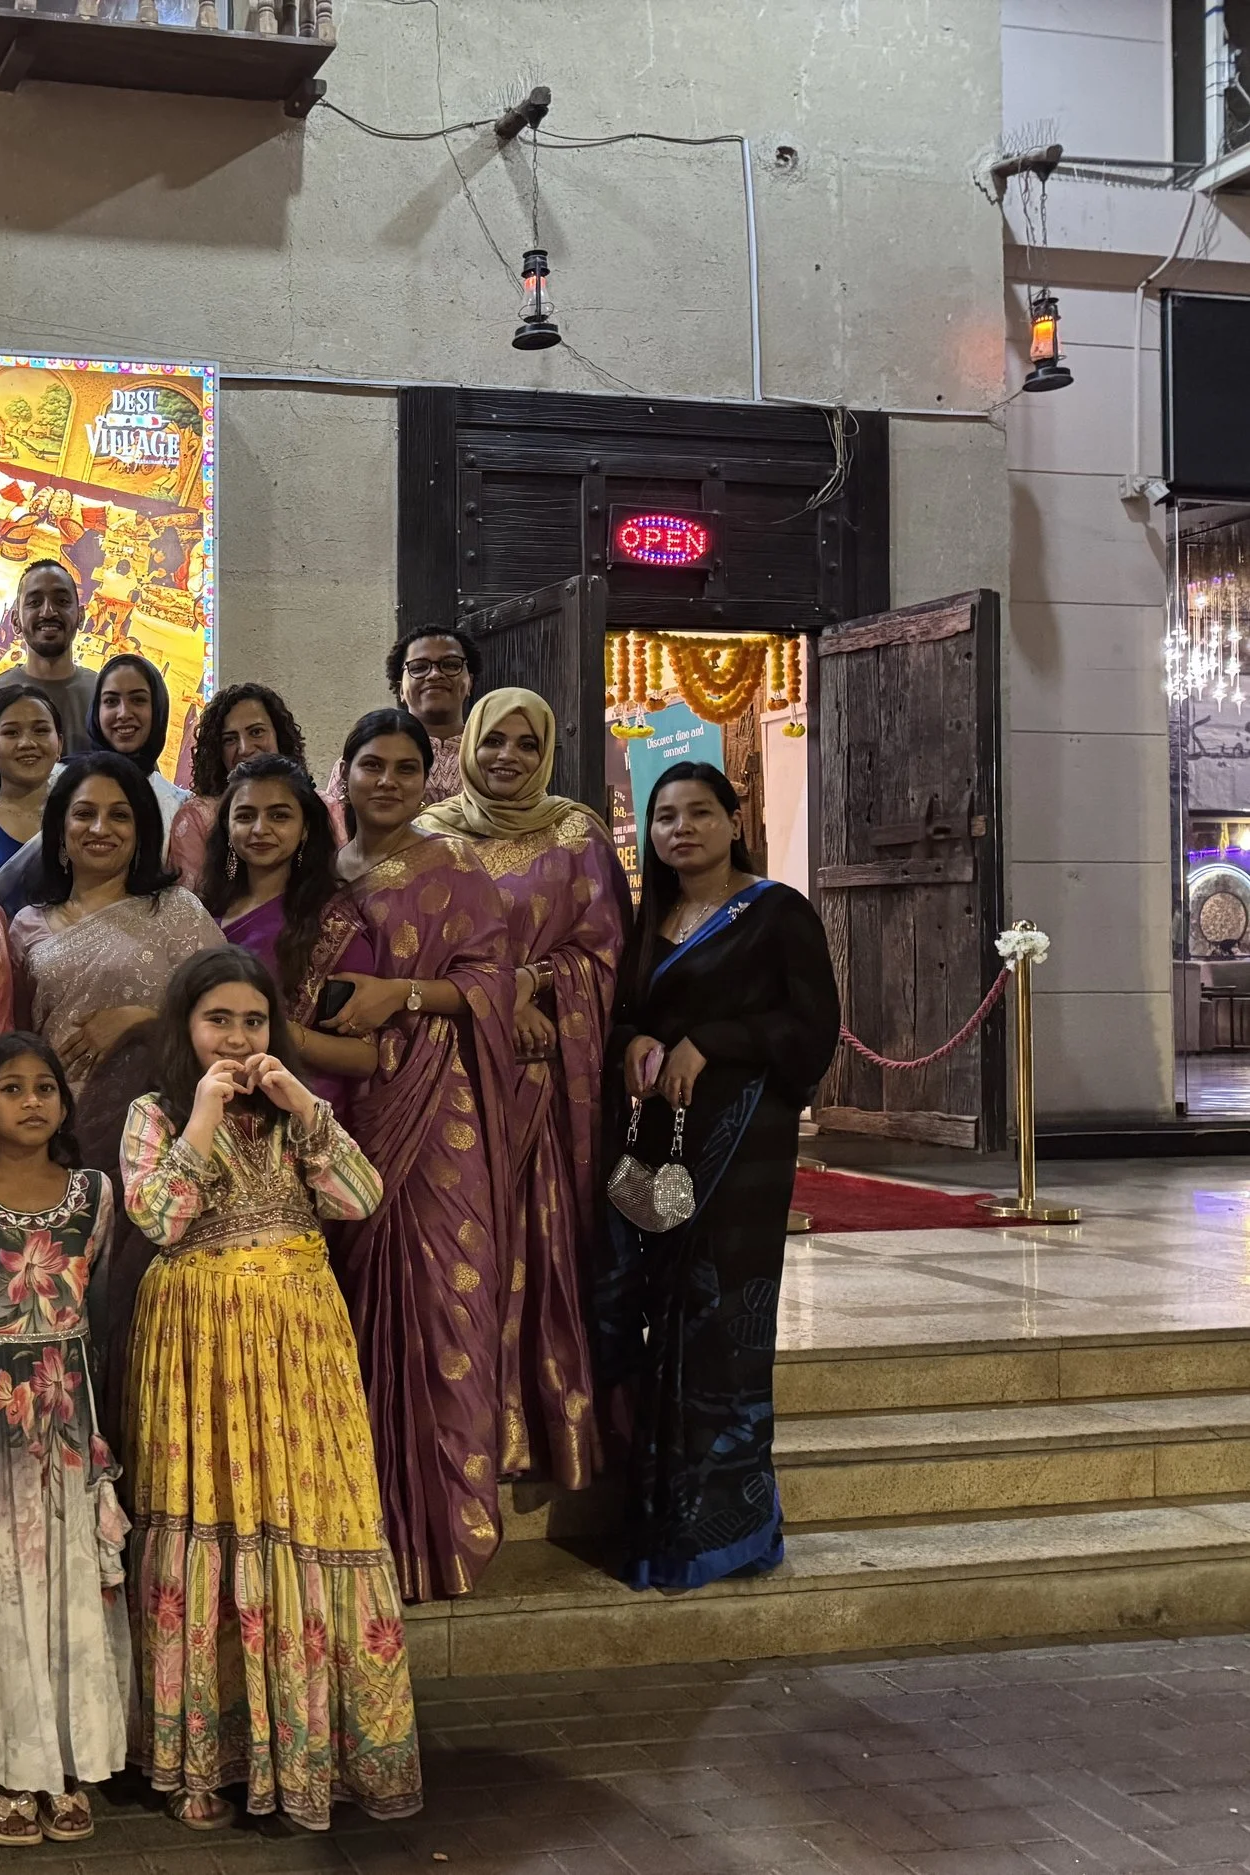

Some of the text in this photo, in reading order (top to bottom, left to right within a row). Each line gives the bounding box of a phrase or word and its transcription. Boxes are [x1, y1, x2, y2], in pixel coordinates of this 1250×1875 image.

[111, 389, 156, 413] DESI
[84, 423, 180, 460] VILLAGE
[621, 527, 707, 554] OPEN
[646, 734, 674, 750] Discover
[690, 723, 705, 738] and
[616, 845, 637, 871] REE
